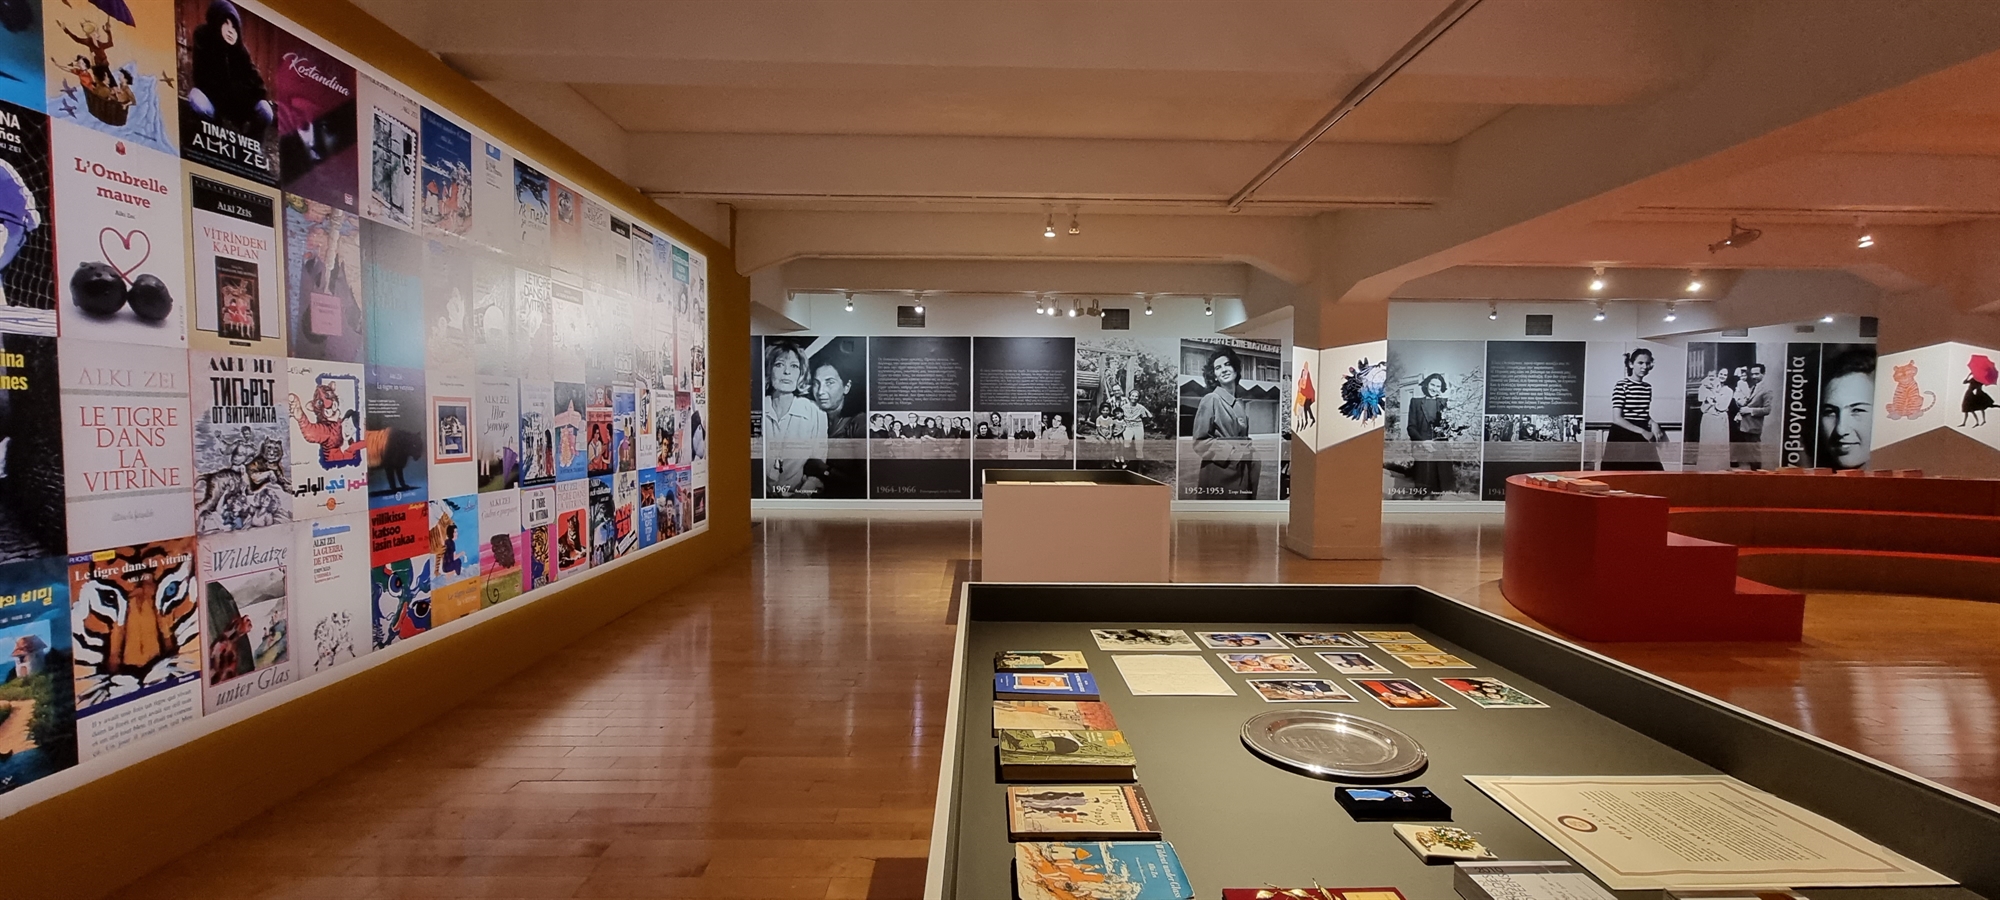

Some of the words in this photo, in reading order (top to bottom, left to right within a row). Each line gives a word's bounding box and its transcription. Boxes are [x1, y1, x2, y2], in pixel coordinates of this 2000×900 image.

[282, 52, 350, 97] Kostandina
[201, 120, 236, 142] TINA'S
[238, 134, 261, 152] WEB
[192, 133, 236, 159] ALKI
[243, 150, 270, 171] ZEI
[74, 157, 168, 195] L'Ombrelle
[97, 186, 151, 208] mauve
[212, 240, 259, 260] KAPLAN
[78, 367, 133, 387] ALKI
[144, 371, 175, 389] ZEI
[80, 406, 105, 427] LE
[111, 406, 178, 427] TIGRE
[212, 406, 224, 424] ОТ
[226, 406, 277, 424] ВИТРИНАТА
[97, 427, 165, 448] DANS
[119, 448, 148, 468] LA
[83, 468, 180, 492] VITRINE
[772, 485, 791, 493] 1967
[876, 485, 916, 494] 1964-1966
[1184, 487, 1225, 495] 1952-1953
[372, 525, 401, 539] katsoo
[372, 538, 392, 552] lasin
[393, 534, 415, 547] takaa
[75, 570, 91, 582] Le
[93, 566, 119, 579] tigre
[122, 562, 147, 573] dans
[149, 559, 158, 569] la
[160, 553, 192, 566] vitrine
[213, 546, 288, 572] Wildkatze
[21, 586, 52, 606] 비밀
[215, 683, 254, 706] unter
[258, 667, 291, 693] Glas
